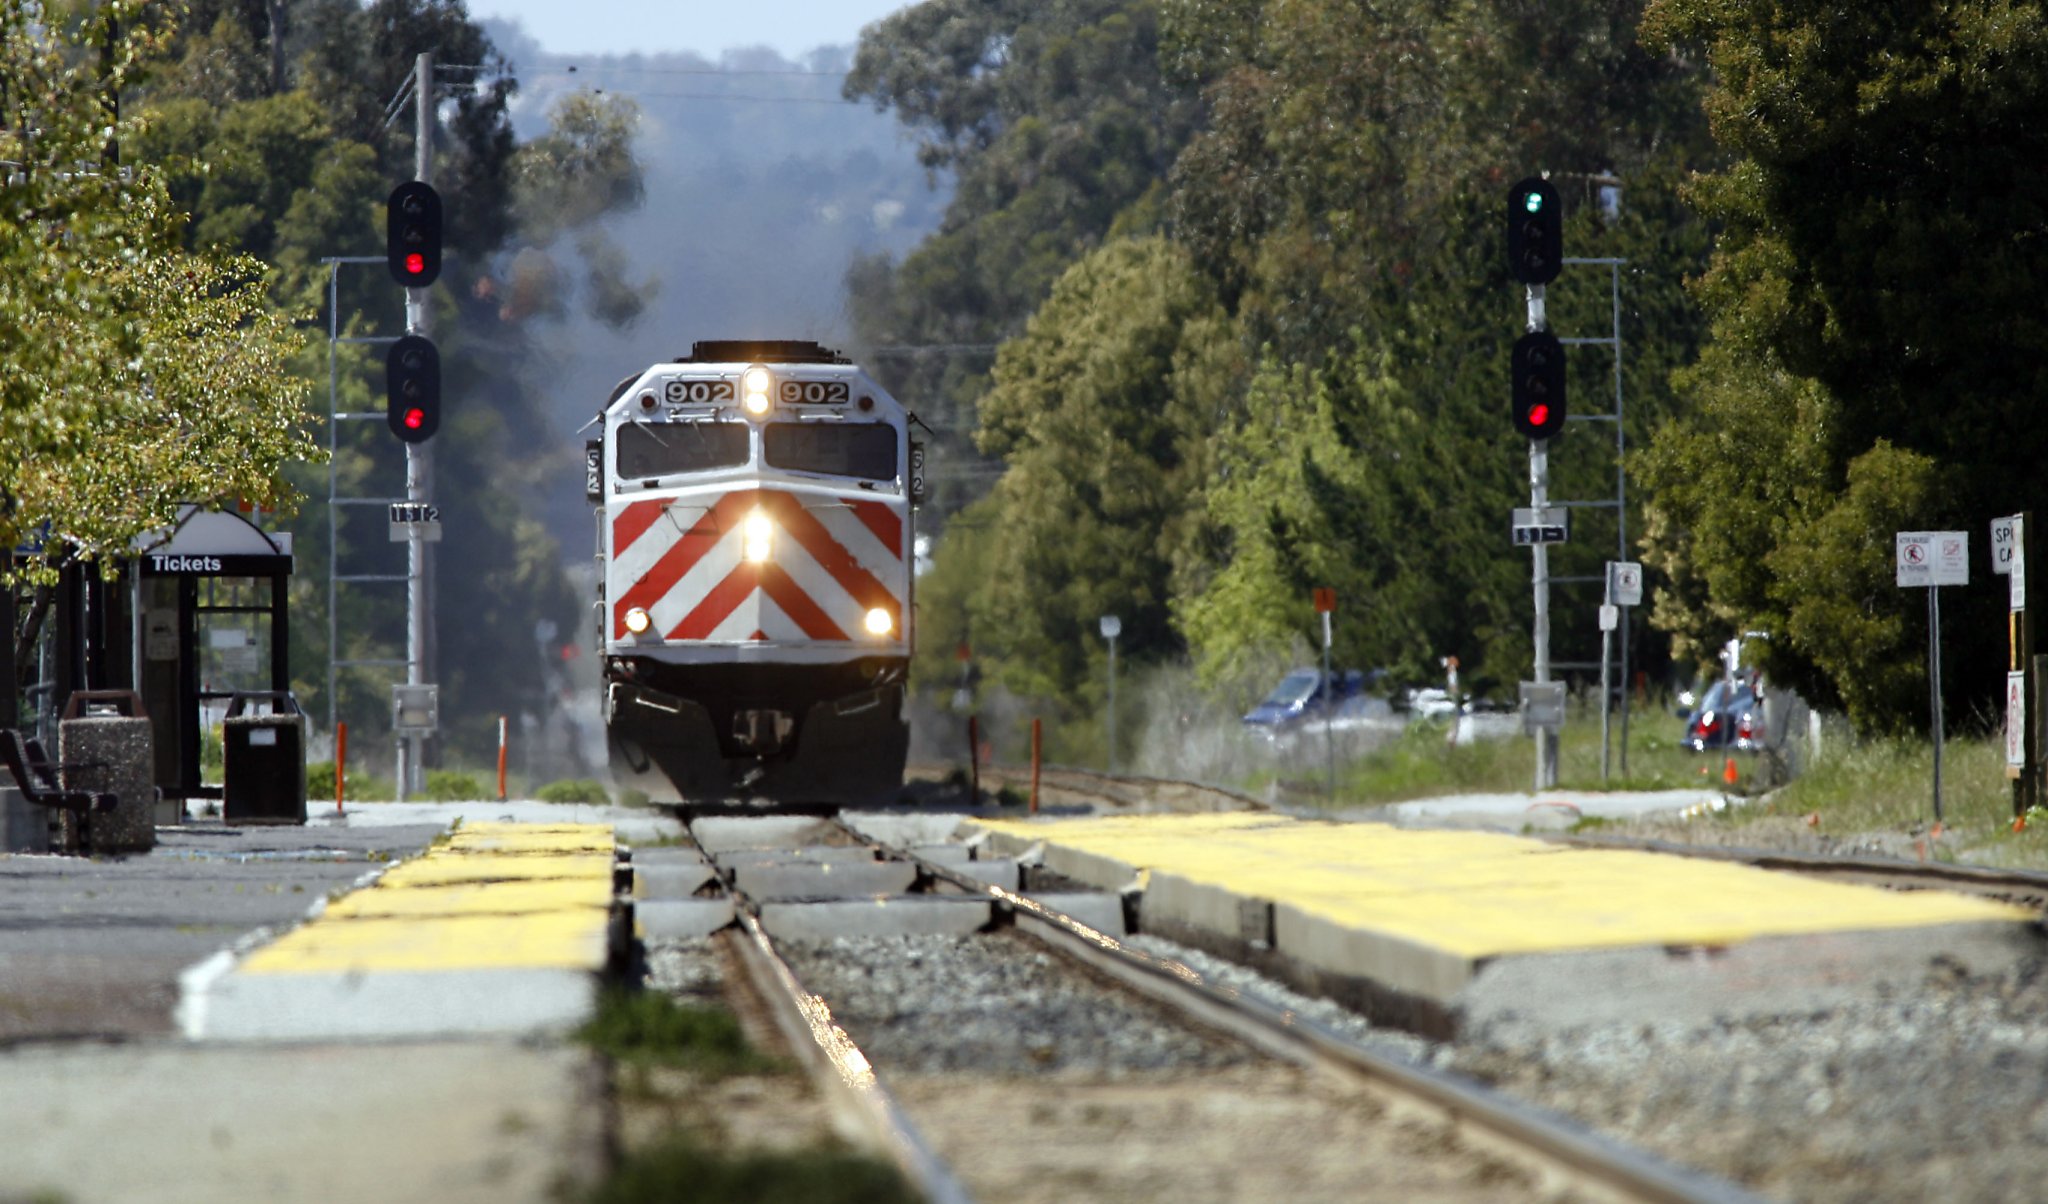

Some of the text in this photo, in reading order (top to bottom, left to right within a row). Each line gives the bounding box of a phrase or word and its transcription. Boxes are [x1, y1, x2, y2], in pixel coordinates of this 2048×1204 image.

[667, 382, 732, 403] 902
[782, 382, 847, 403] 902
[152, 555, 221, 571] Tickets
